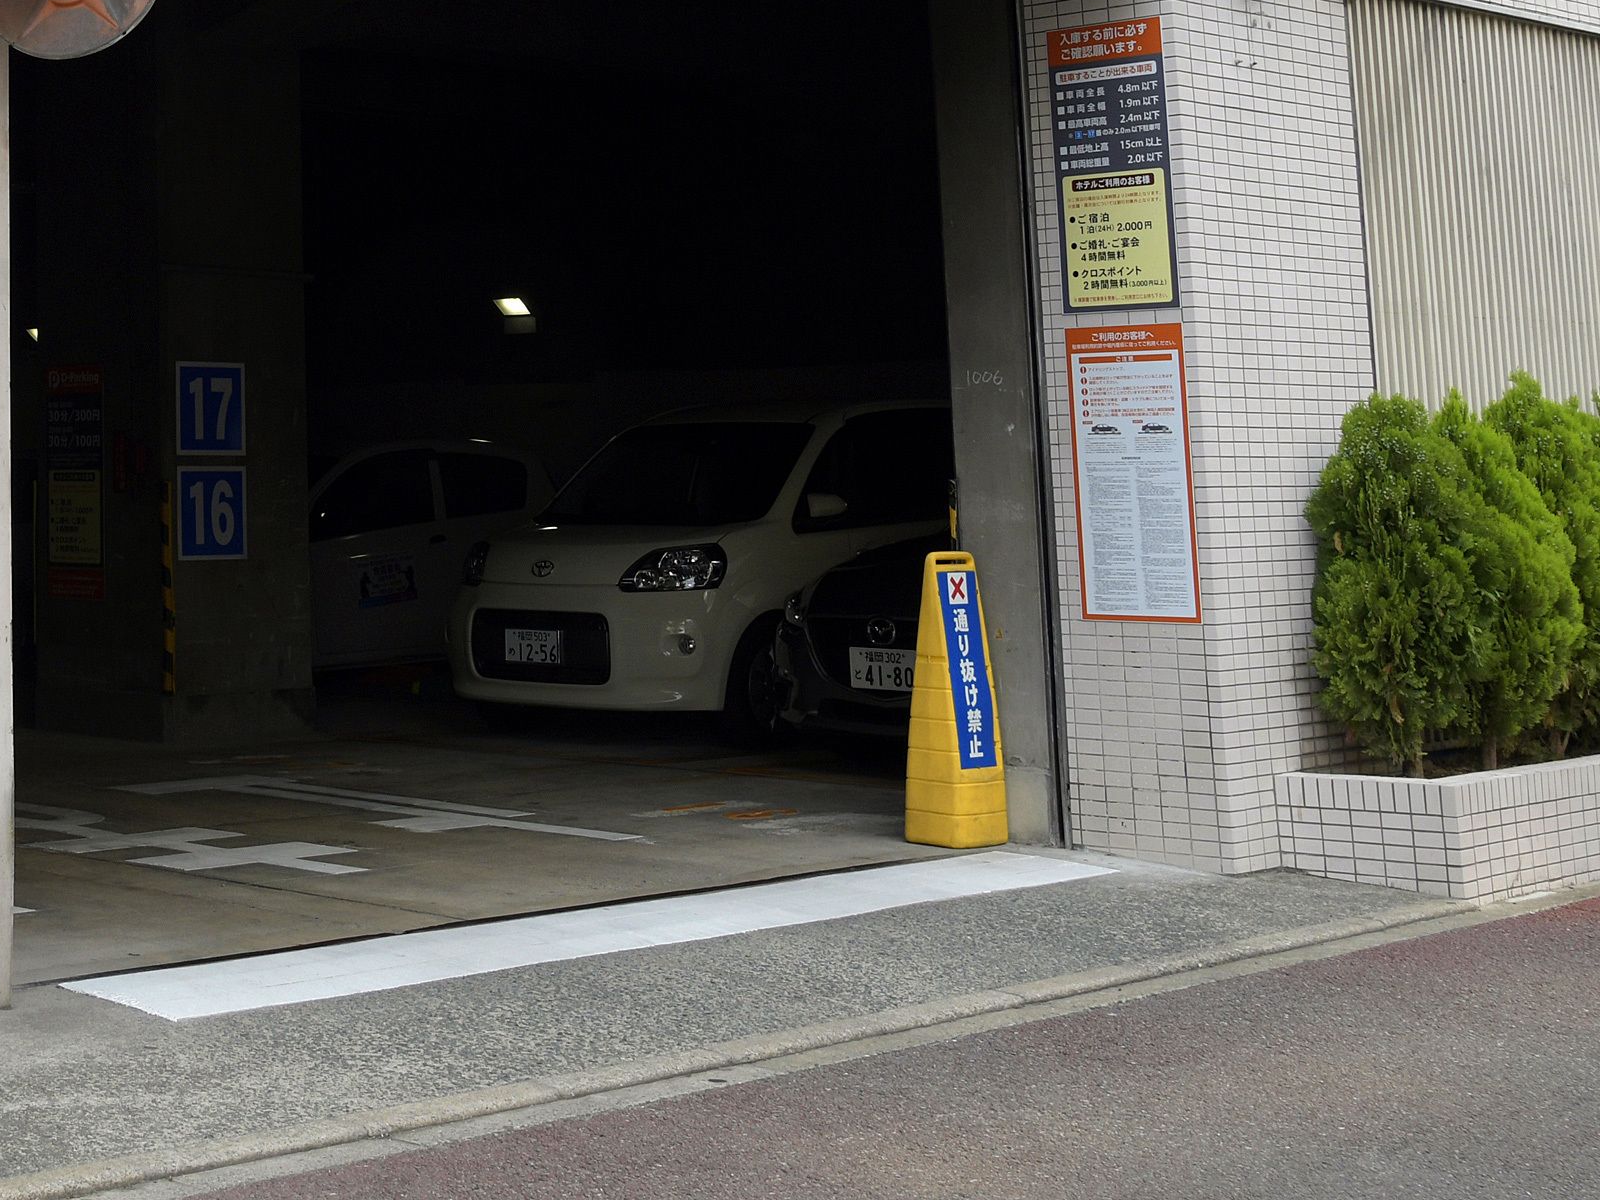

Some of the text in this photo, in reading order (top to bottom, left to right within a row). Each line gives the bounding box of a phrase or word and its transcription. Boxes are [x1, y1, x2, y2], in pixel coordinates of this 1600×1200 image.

[1060, 23, 1148, 46] 入庫する前に必ず
[1061, 40, 1143, 61] ご確認願います。
[188, 377, 233, 441] 17
[189, 479, 235, 546] 16
[953, 608, 984, 760] 通り抜け禁止
